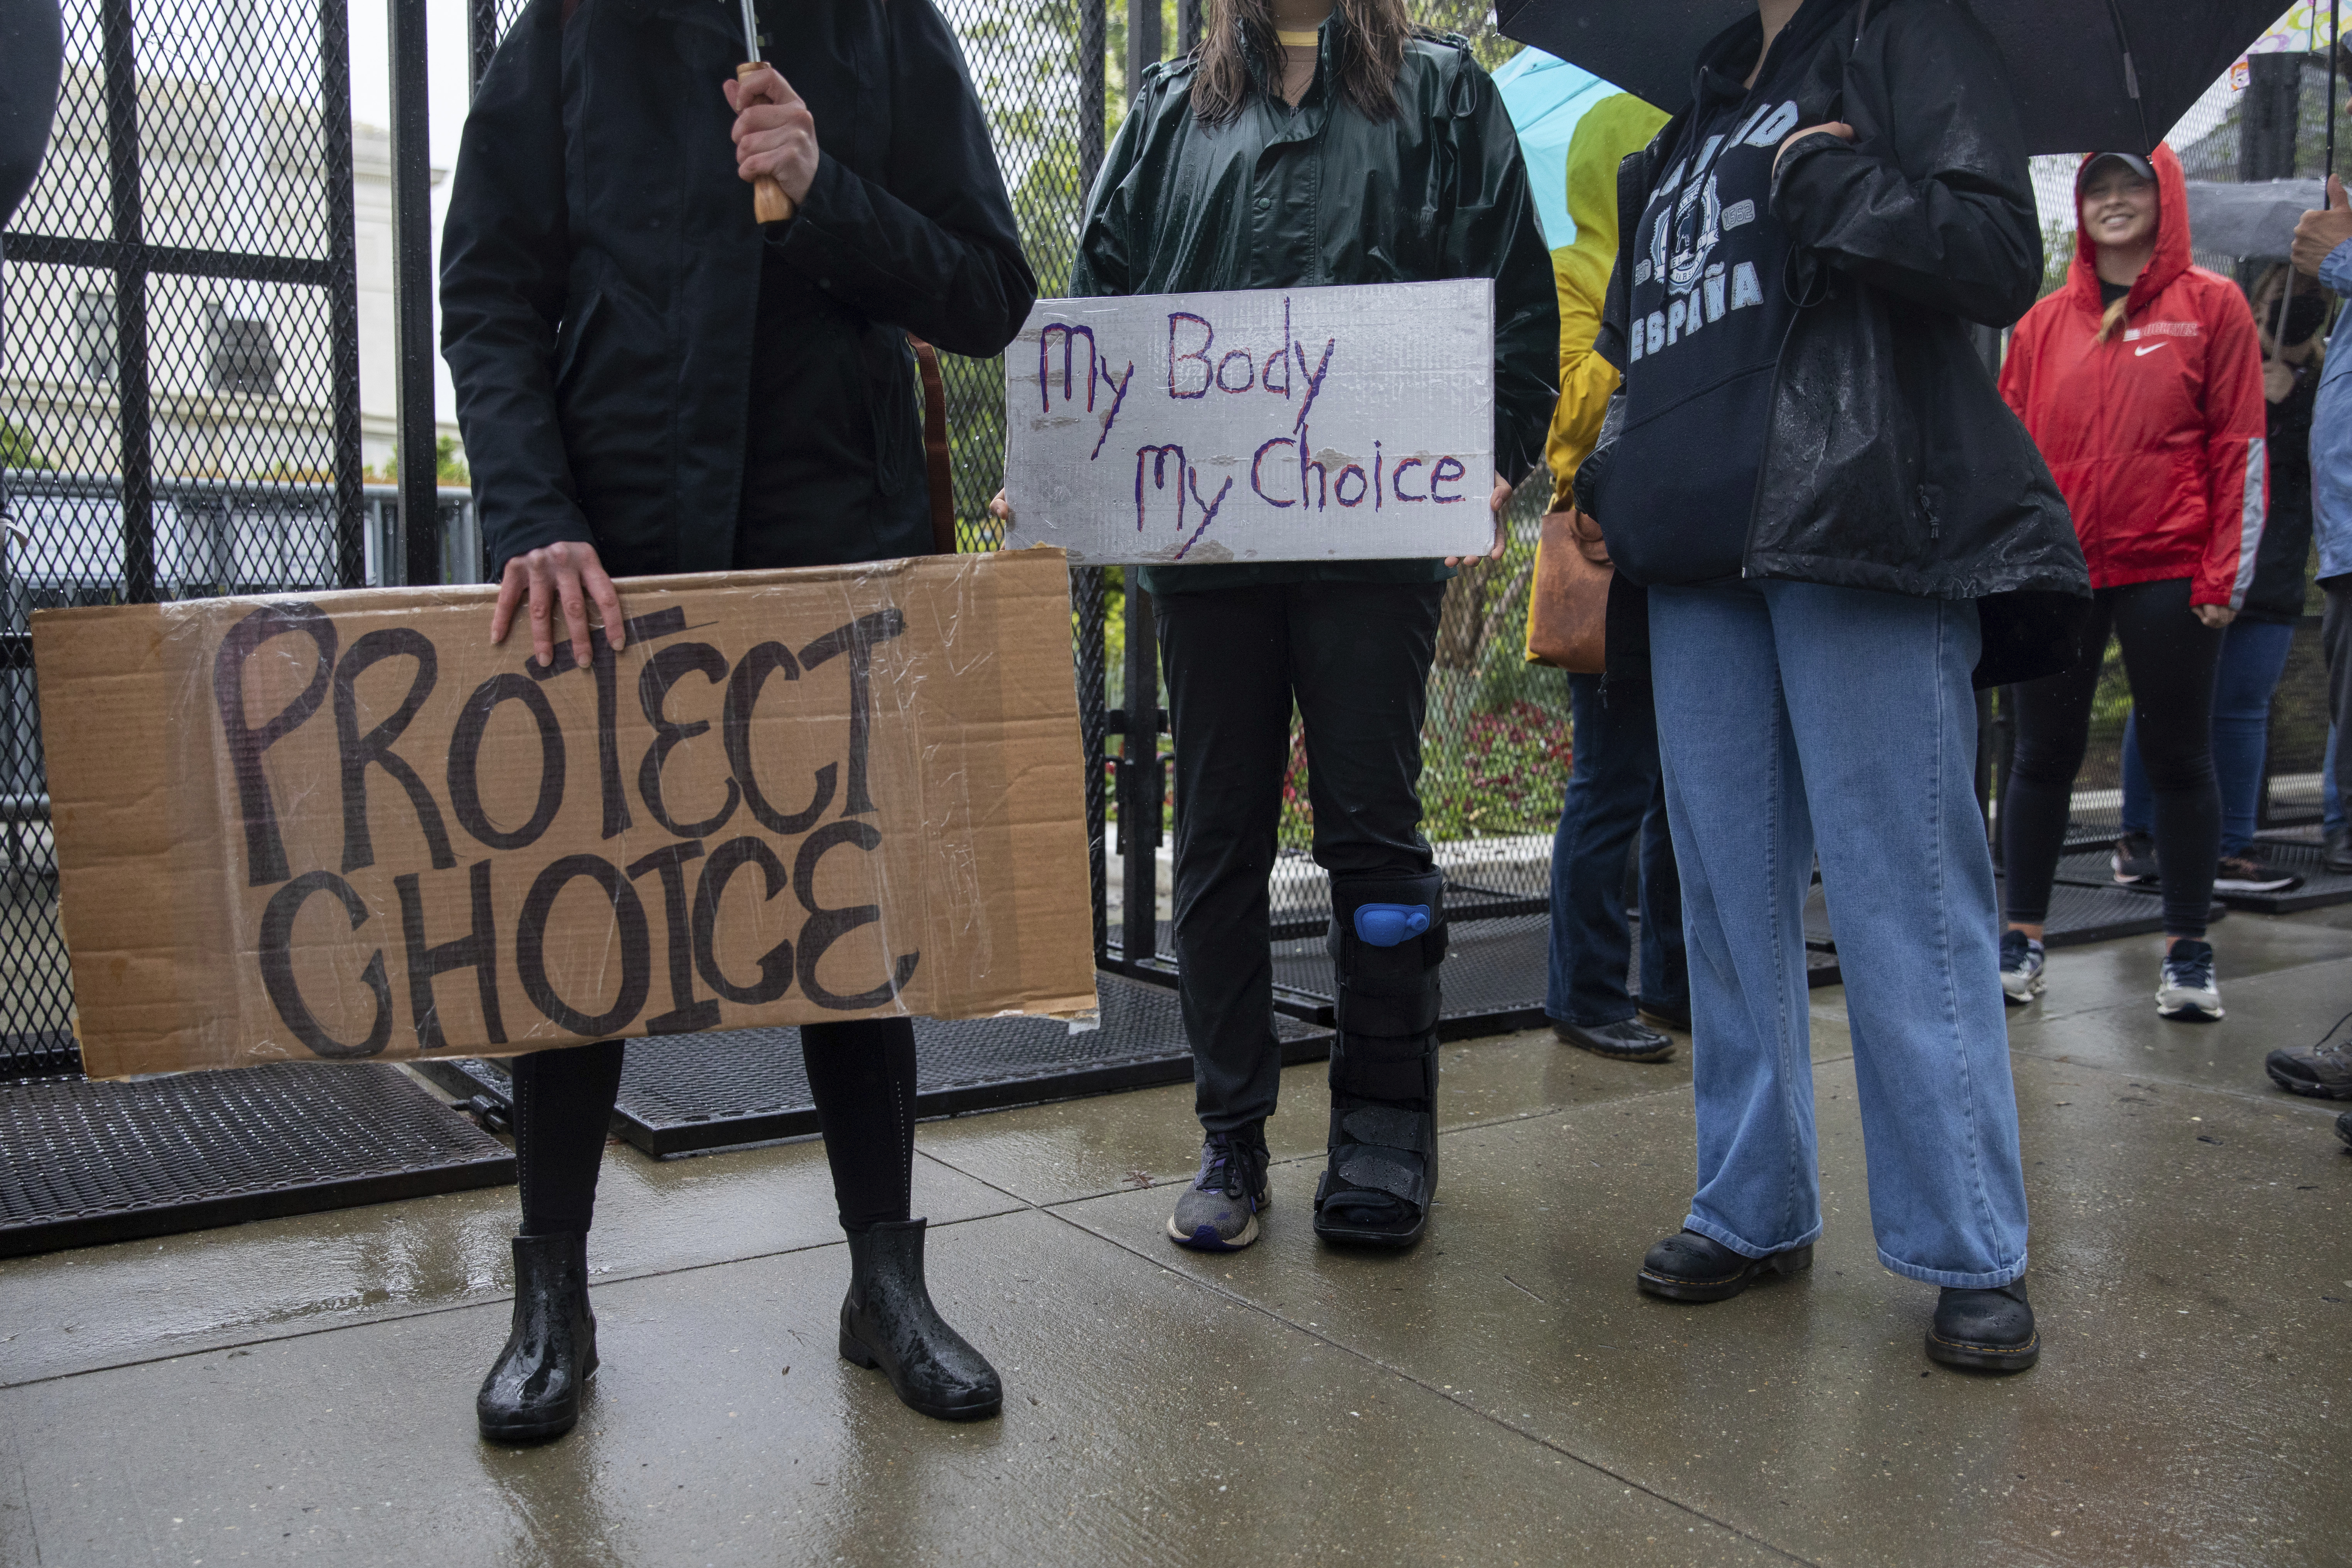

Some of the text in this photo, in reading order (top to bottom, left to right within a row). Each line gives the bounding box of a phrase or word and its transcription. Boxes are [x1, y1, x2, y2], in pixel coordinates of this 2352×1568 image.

[1723, 202, 1754, 228] 1562
[1039, 297, 1335, 460] My Body
[1630, 261, 1764, 364] ESPAÑA
[1135, 422, 1466, 559] My Choice
[218, 600, 905, 887] PROTECT
[258, 820, 921, 1058] CHOICE
